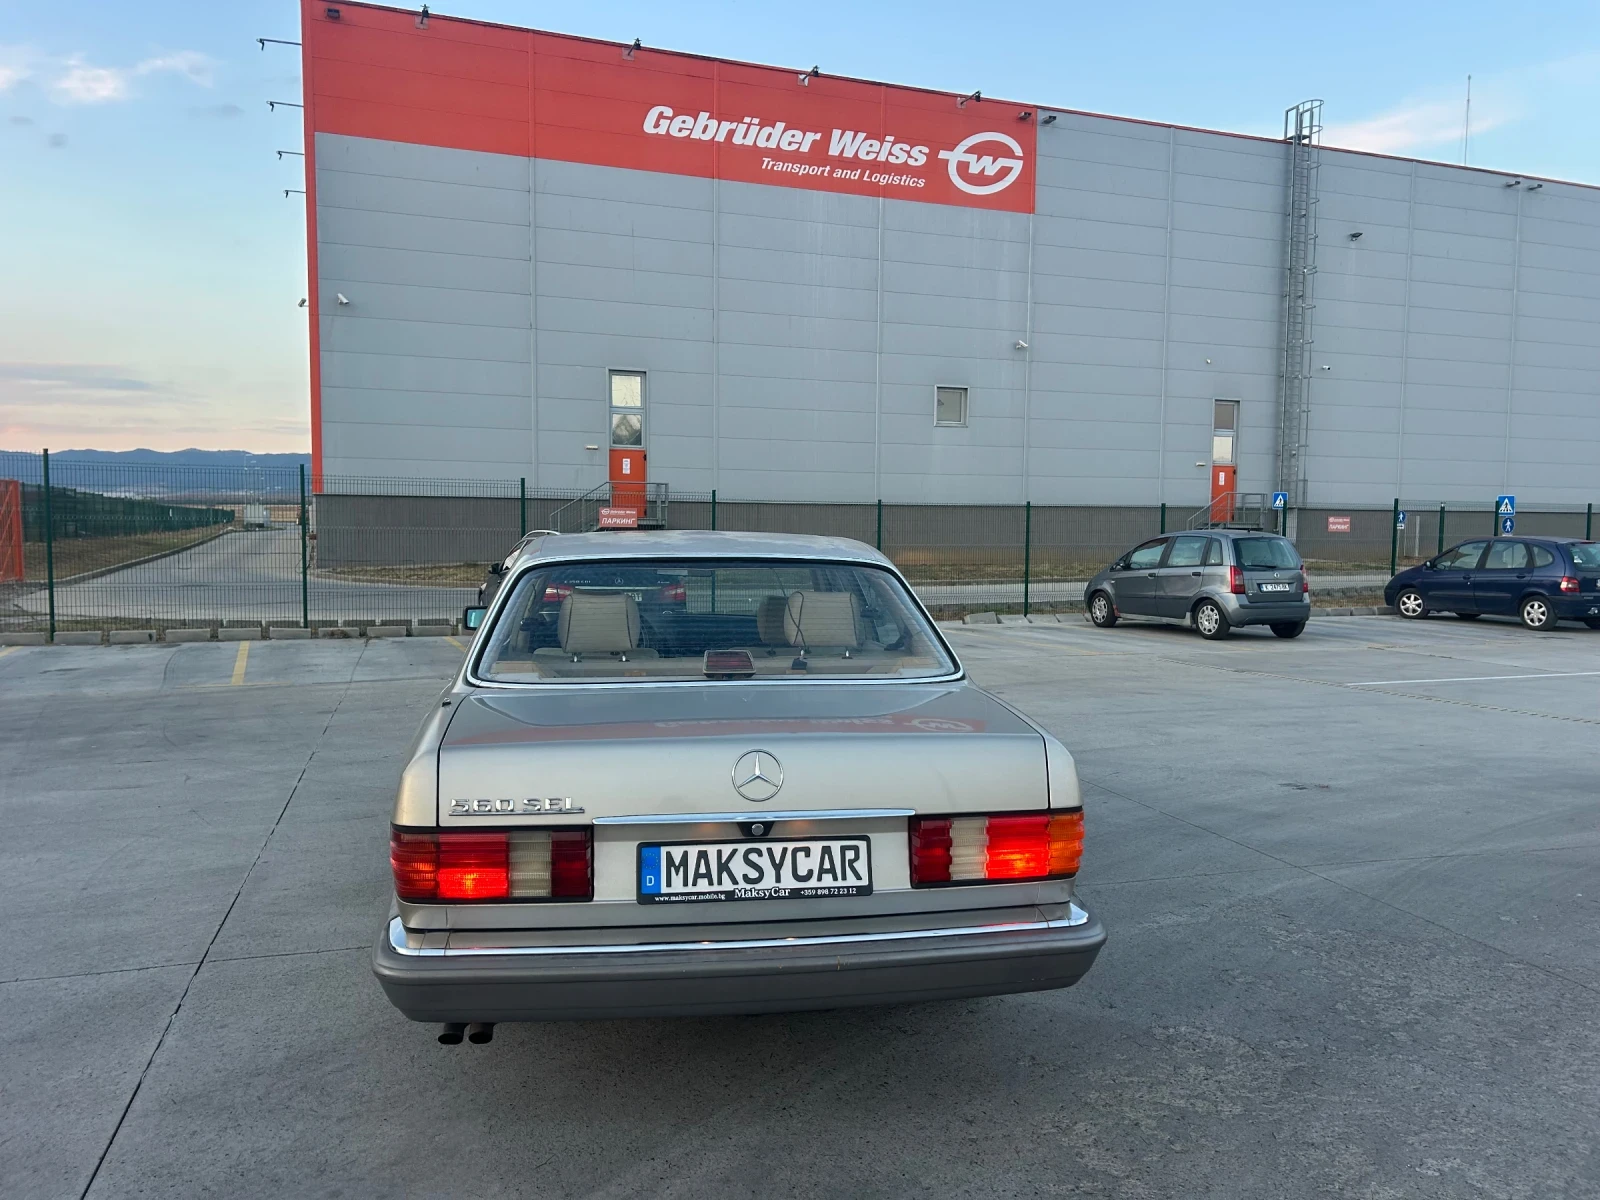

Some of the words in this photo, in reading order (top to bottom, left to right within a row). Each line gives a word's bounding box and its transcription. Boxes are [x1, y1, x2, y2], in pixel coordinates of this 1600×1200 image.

[643, 105, 821, 153] Gebrüder
[828, 128, 929, 166] Weiss
[761, 157, 831, 178] Transport
[833, 167, 858, 181] and
[863, 173, 926, 188] Logistics
[601, 517, 636, 525] ПАРКИНГ
[450, 798, 514, 812] 560
[522, 797, 583, 811] SEL
[665, 845, 862, 887] MAKSYCAR
[646, 875, 655, 886] D
[654, 893, 726, 902] www.maksycar.mobile.bg
[734, 887, 791, 899] MaksyCar
